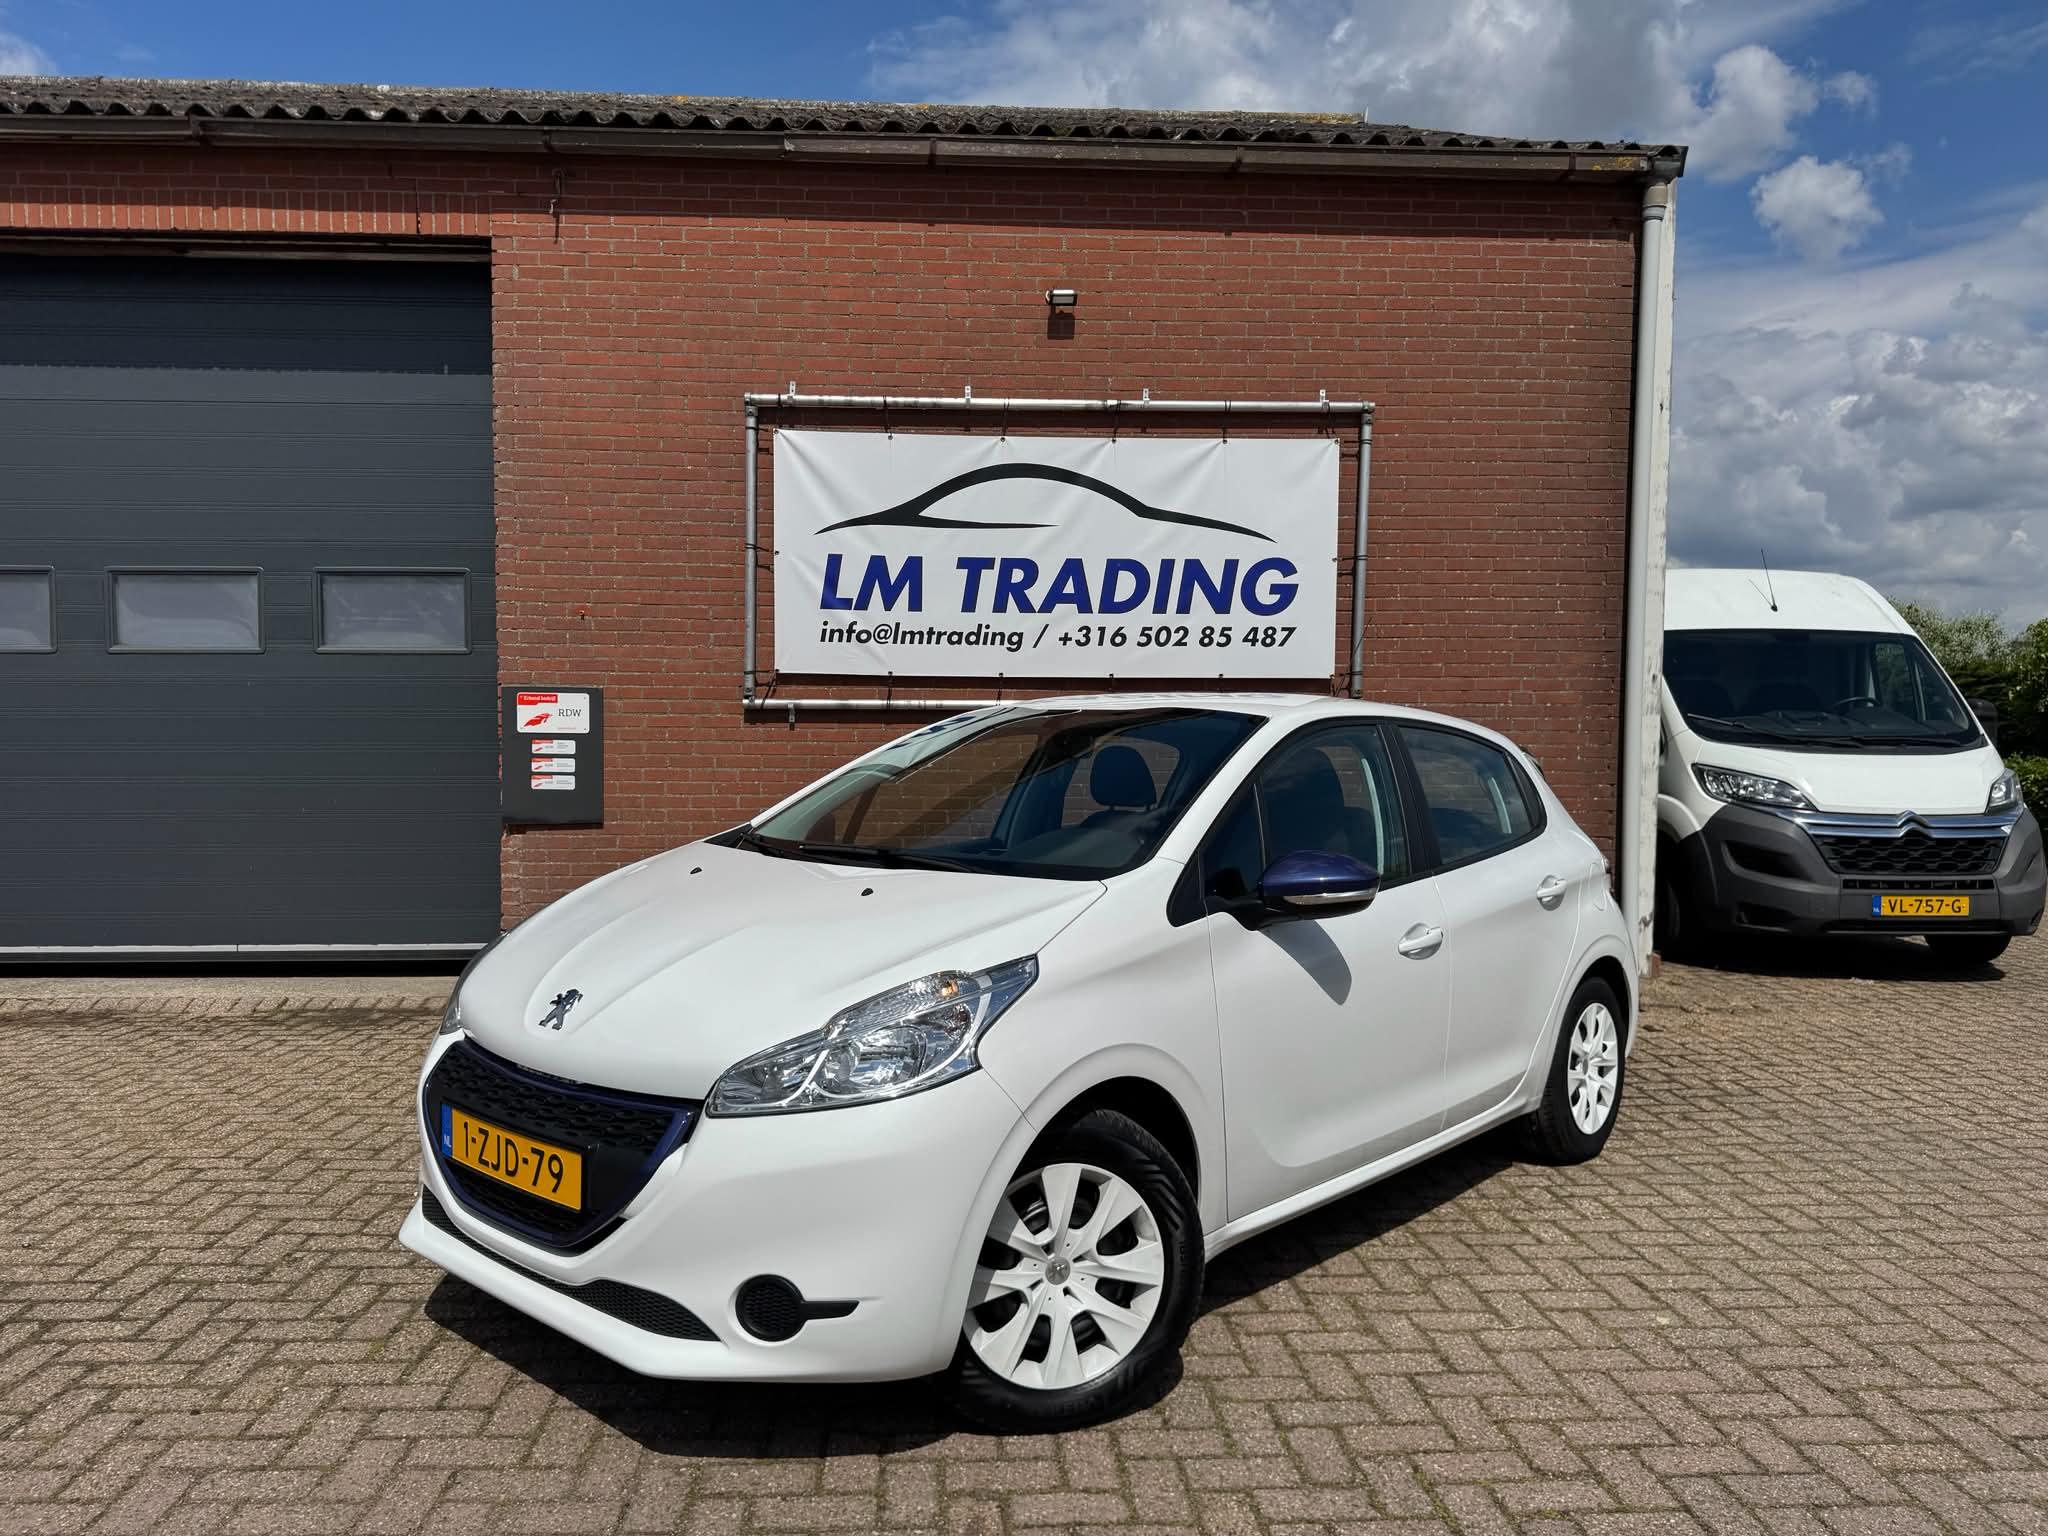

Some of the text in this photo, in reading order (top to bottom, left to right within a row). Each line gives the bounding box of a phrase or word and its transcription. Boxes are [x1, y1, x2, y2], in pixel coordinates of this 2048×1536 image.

[819, 553, 1300, 617] LM TRADING
[819, 620, 1024, 653] info@lmtrading
[1057, 625, 1128, 648] +316
[1136, 626, 1189, 648] 502
[1198, 626, 1233, 648] 85
[1242, 626, 1298, 648] 487
[558, 708, 582, 717] RDW
[1888, 899, 1962, 913] VL-757-G
[443, 1121, 564, 1194] NL 1-ZJD-79
